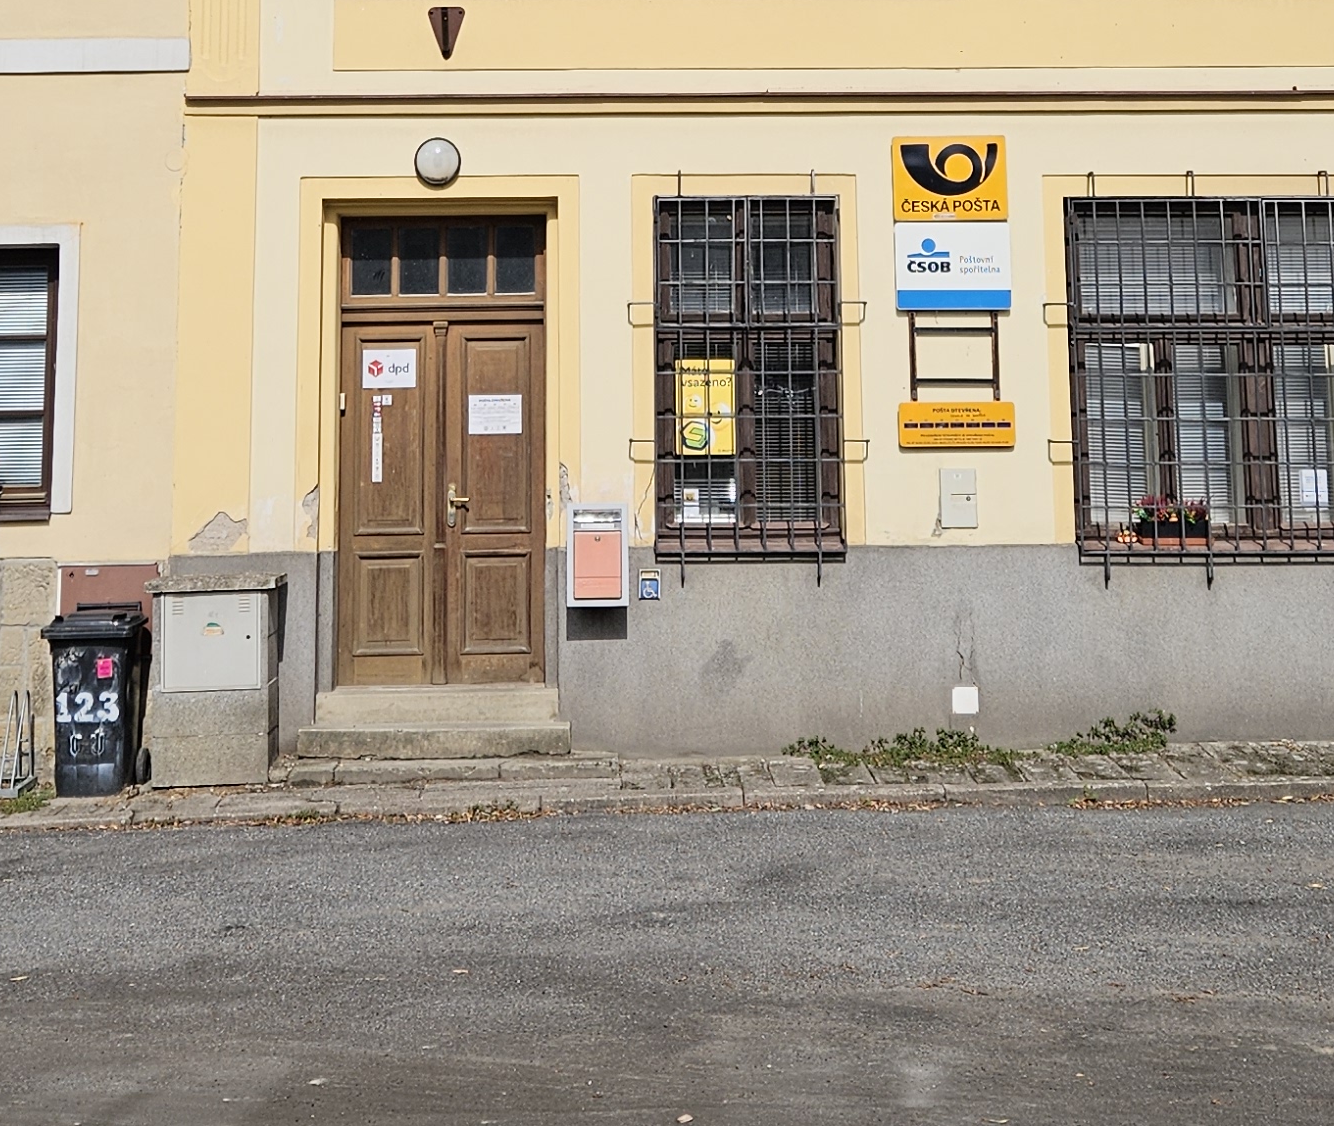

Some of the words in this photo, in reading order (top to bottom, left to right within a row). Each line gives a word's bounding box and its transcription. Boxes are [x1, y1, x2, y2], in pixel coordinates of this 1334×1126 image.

[901, 198, 950, 213] ČESKÁ
[952, 197, 1001, 212] POŠTA
[959, 255, 994, 264] Poštovní
[907, 260, 951, 273] ČSOB
[959, 265, 1001, 275] spořitelna
[388, 363, 410, 376] dpd
[681, 377, 732, 388] vsazeno?
[56, 691, 120, 722] 123
